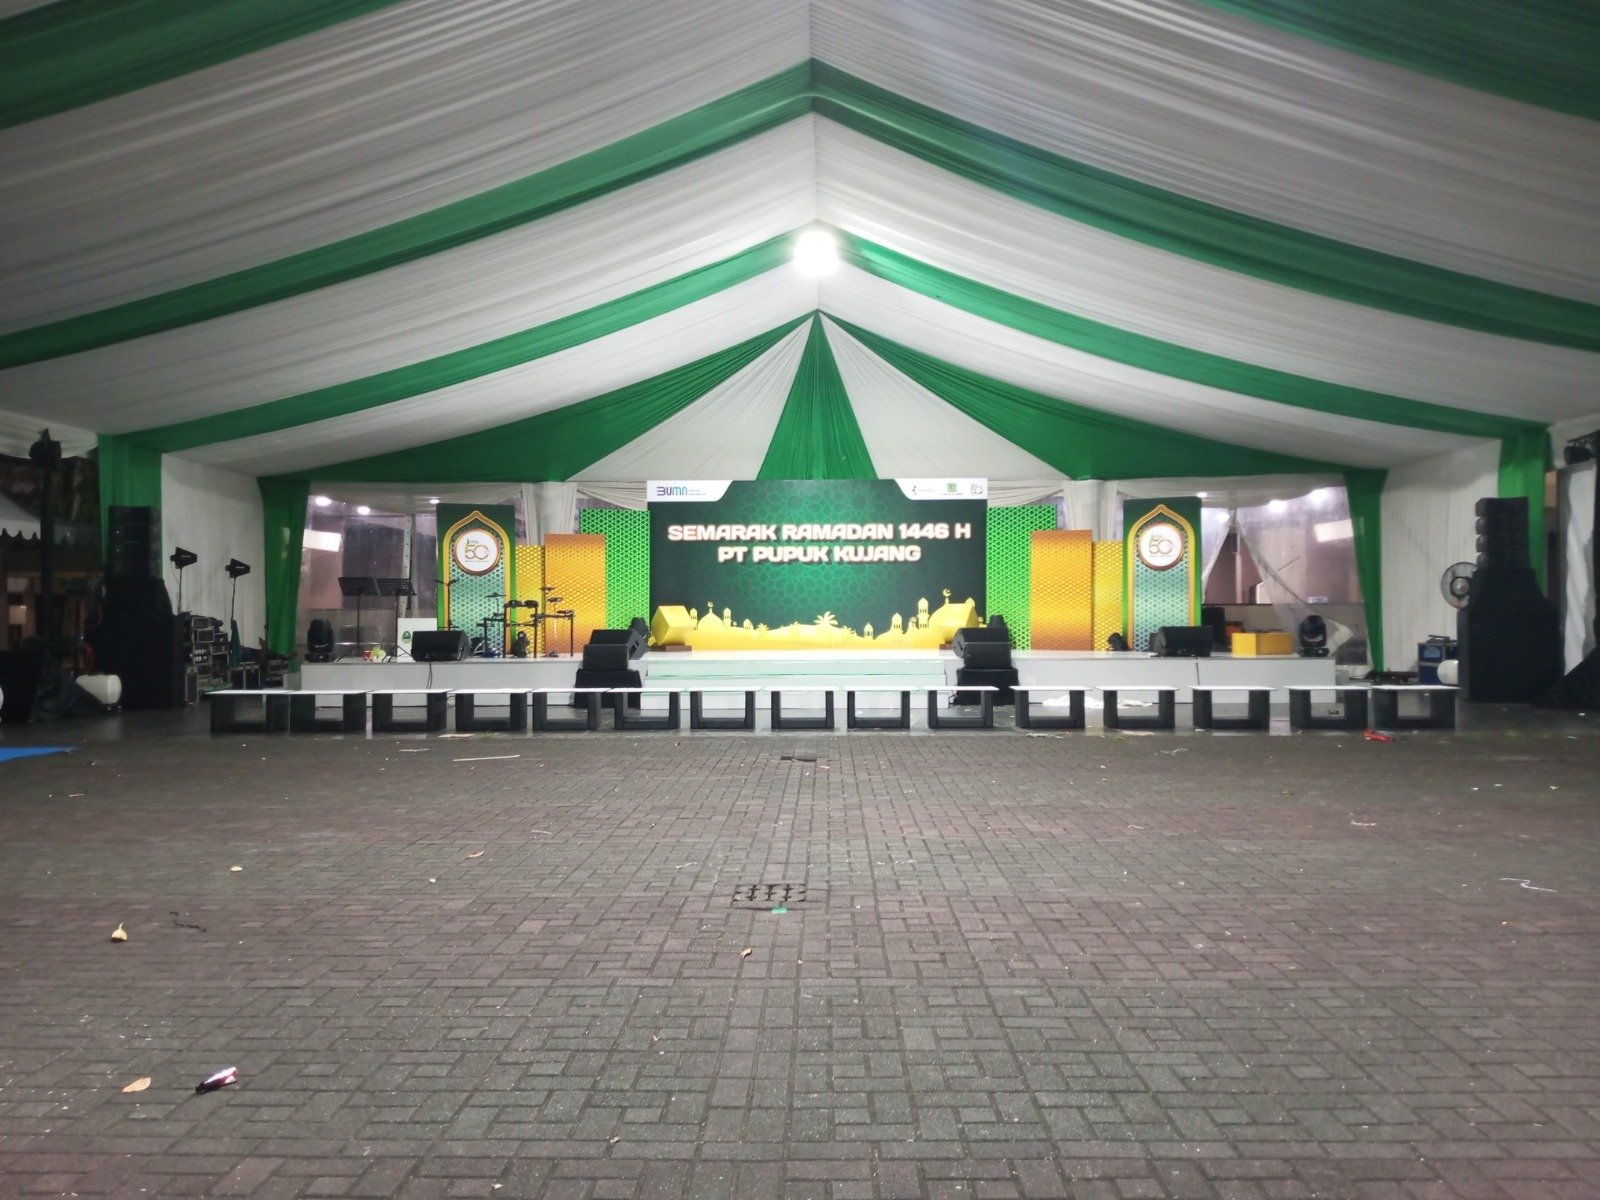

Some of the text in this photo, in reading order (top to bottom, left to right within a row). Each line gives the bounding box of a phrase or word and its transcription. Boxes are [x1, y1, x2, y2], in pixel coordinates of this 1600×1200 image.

[667, 523, 971, 541] SEMARAK RAMADAN 1446 H
[465, 538, 489, 560] 50
[718, 545, 922, 563] PT PUPUK KUJANG
